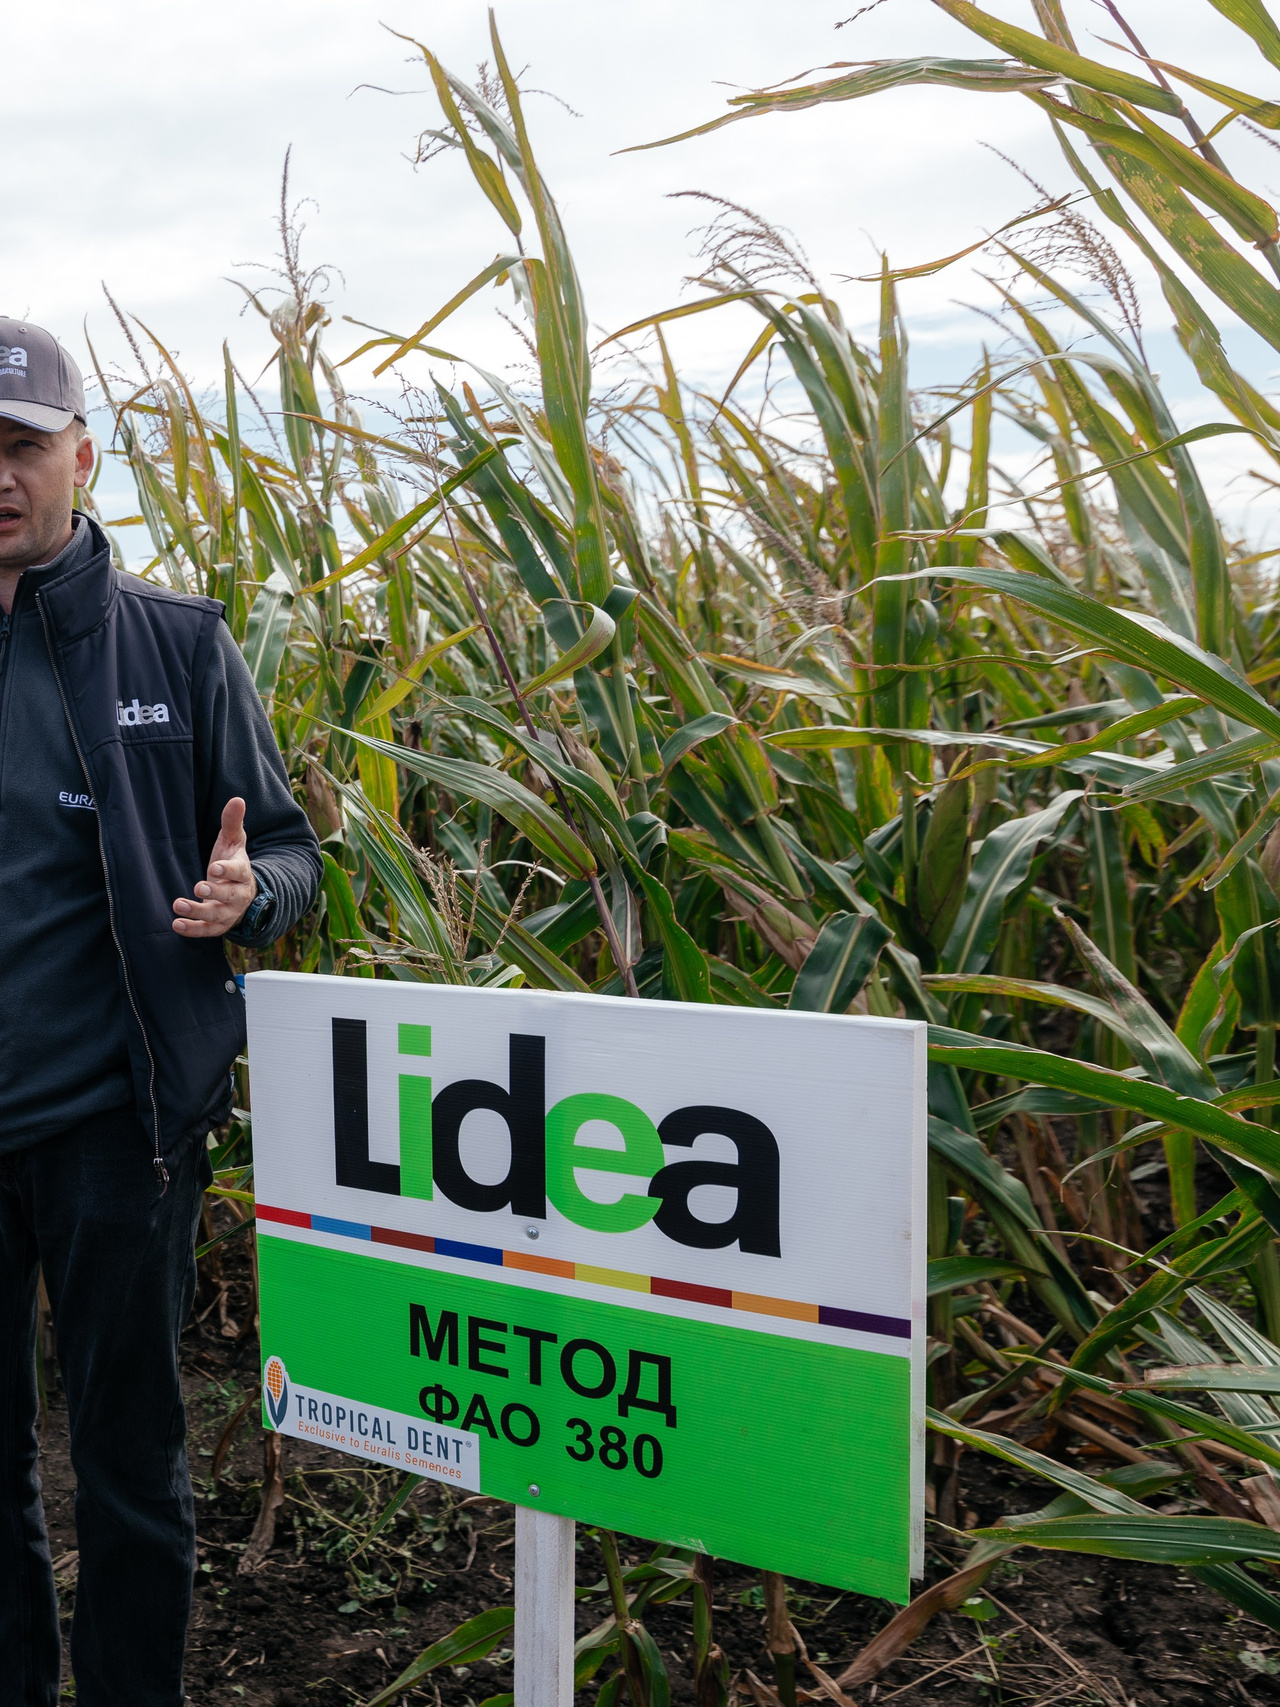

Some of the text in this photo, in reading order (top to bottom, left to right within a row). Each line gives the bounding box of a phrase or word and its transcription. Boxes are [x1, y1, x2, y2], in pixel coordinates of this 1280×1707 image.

[332, 1017, 782, 1259] Lidea
[410, 1302, 677, 1429] МЕТОД
[295, 1394, 396, 1445] TROPICAL
[298, 1421, 462, 1479] Exclusive to Euralis Semences
[419, 1383, 663, 1479] ФАО 380
